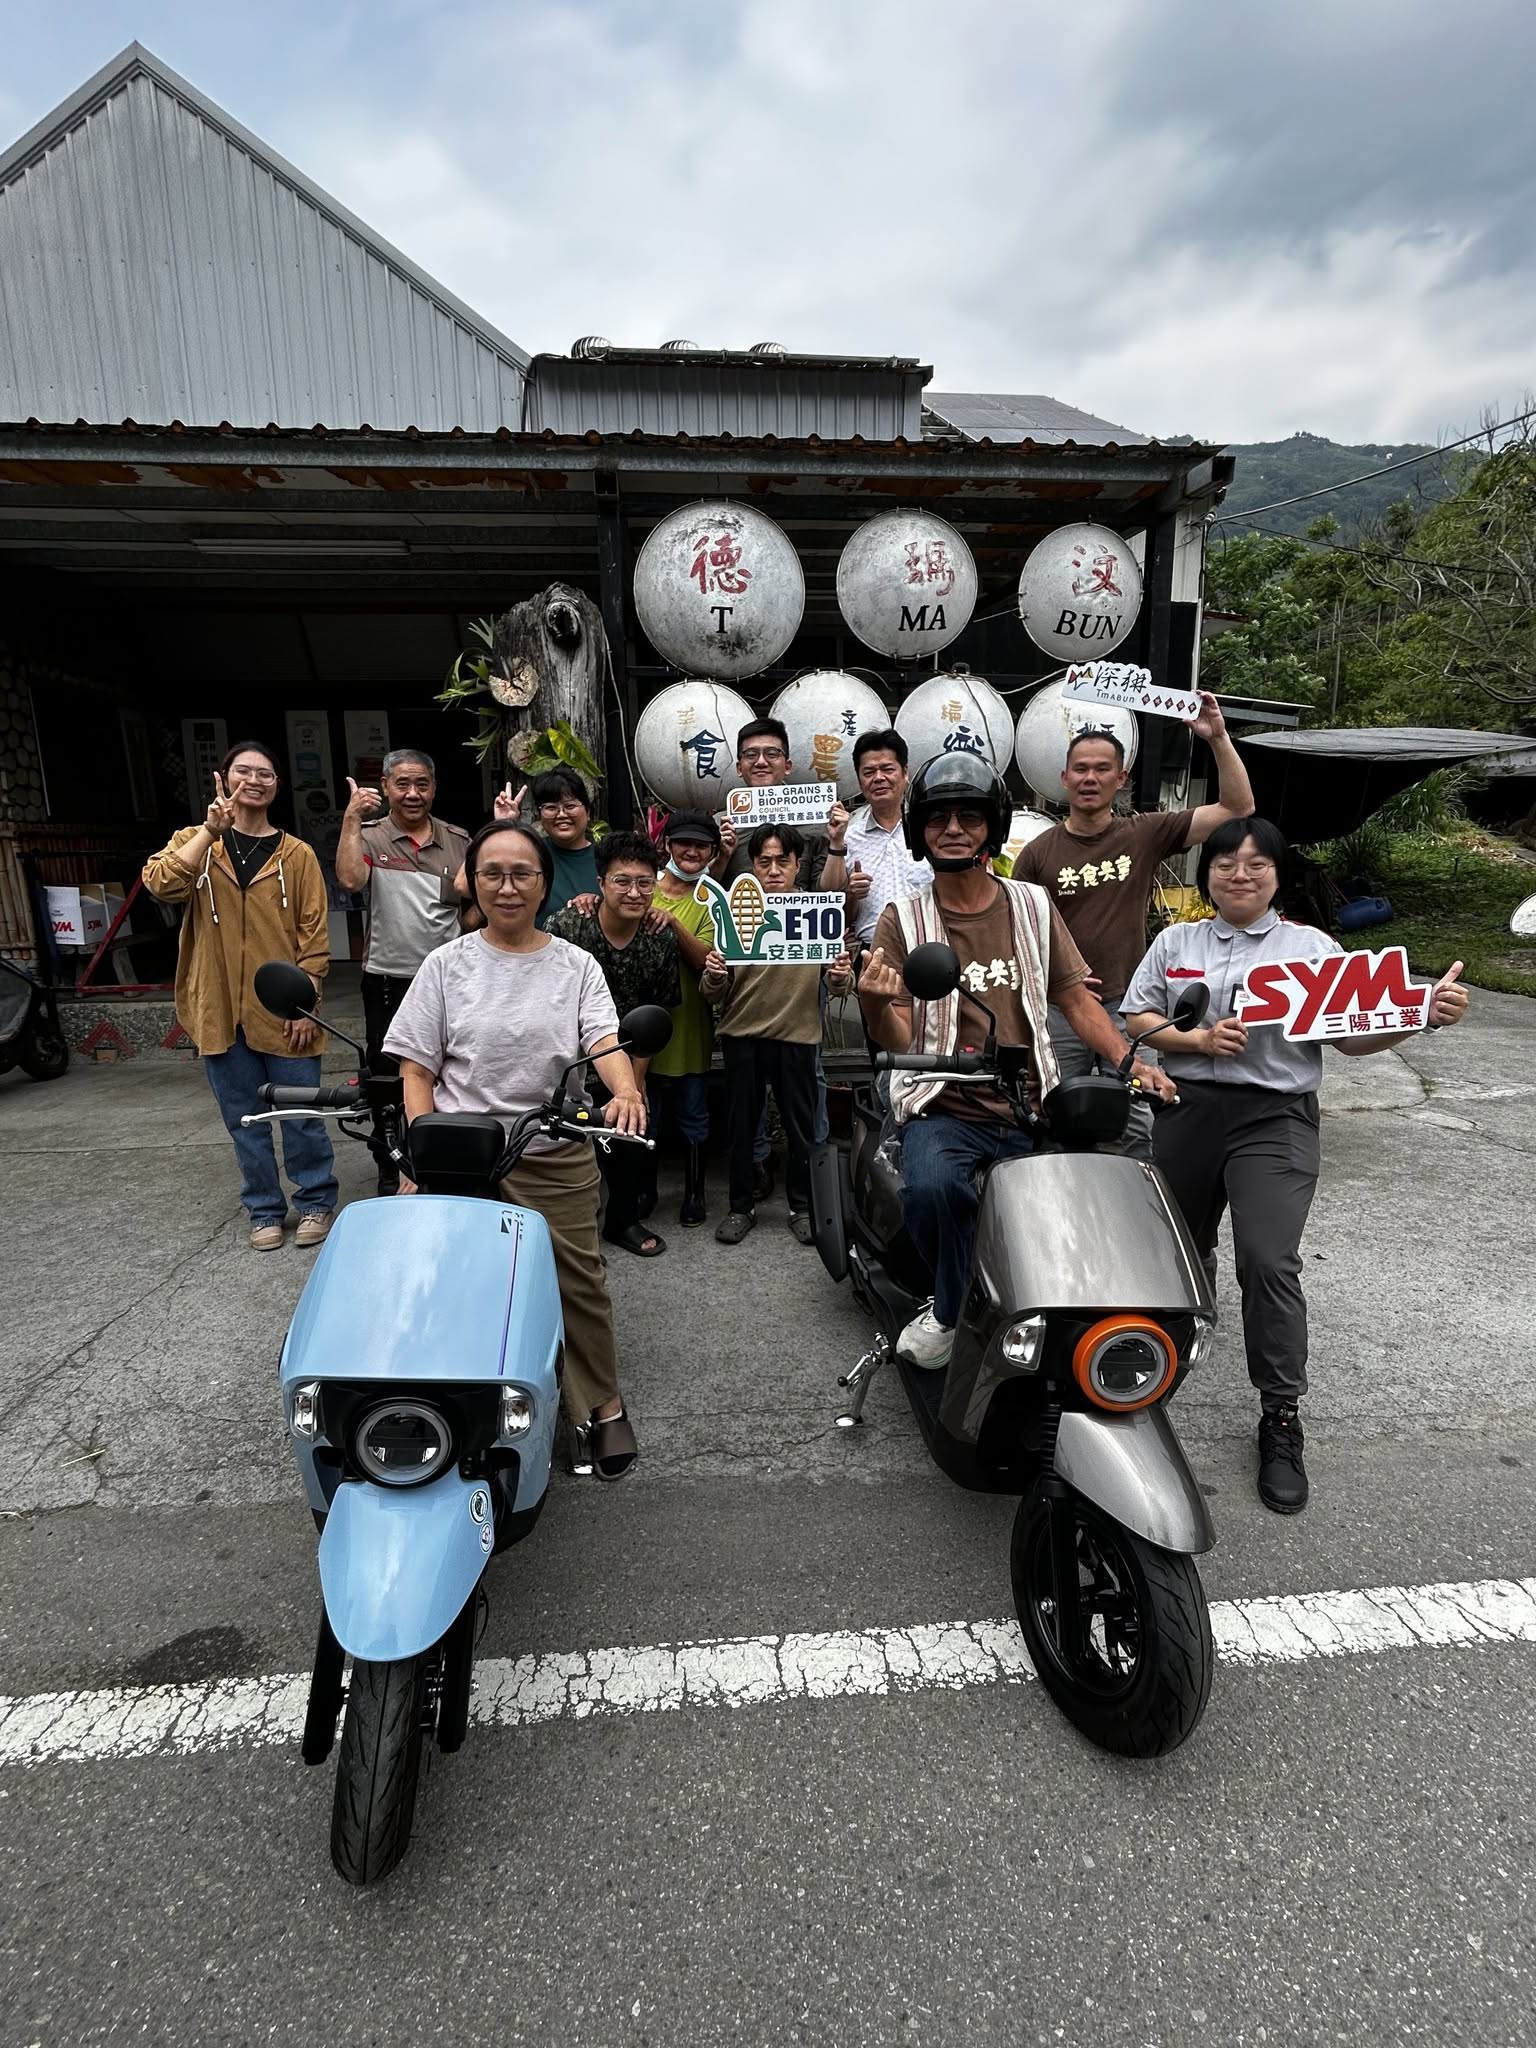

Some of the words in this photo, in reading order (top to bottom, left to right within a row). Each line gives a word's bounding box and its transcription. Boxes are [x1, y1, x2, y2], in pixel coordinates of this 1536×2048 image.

[689, 532, 753, 595] 德
[709, 606, 734, 634] T
[898, 604, 948, 632] MA
[1053, 609, 1123, 640] BUN
[680, 729, 726, 778] 食
[758, 788, 778, 797] U.S.
[782, 785, 821, 796] GRAINS
[826, 785, 834, 794] &
[758, 794, 835, 806] BIOPRODUCTS
[732, 811, 830, 825] 美國穀物暨生質產品協
[758, 806, 791, 814] COUNCIL
[1057, 855, 1132, 889] 共食共享
[767, 895, 843, 905] COMPATIBLE
[785, 907, 842, 941] E10
[768, 943, 842, 960] 安全適用
[1241, 950, 1427, 1036] SYM
[1325, 1007, 1422, 1034] 三陽工業
